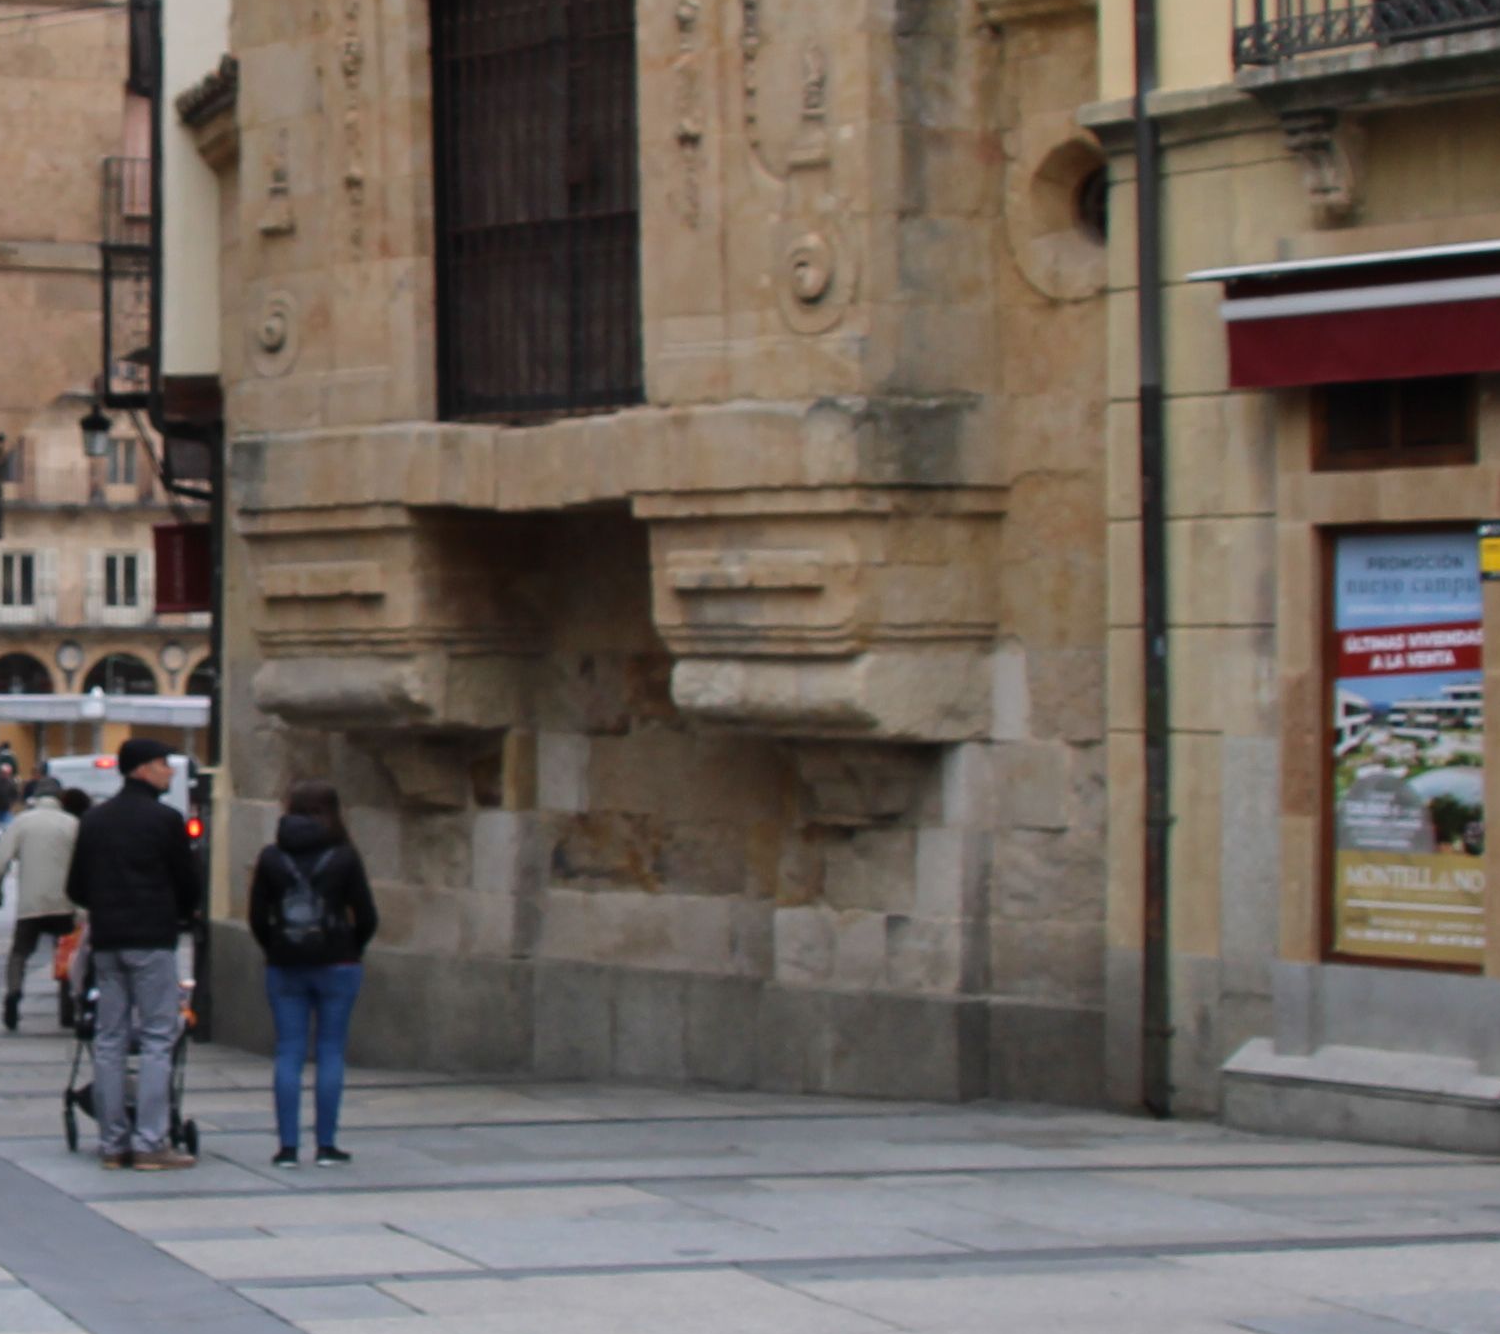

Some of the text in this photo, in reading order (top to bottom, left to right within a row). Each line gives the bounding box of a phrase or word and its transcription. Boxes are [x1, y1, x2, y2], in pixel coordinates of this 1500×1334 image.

[1366, 554, 1464, 571] PROMOCIÓN
[1384, 652, 1406, 670] LA
[1406, 649, 1457, 669] VENTA
